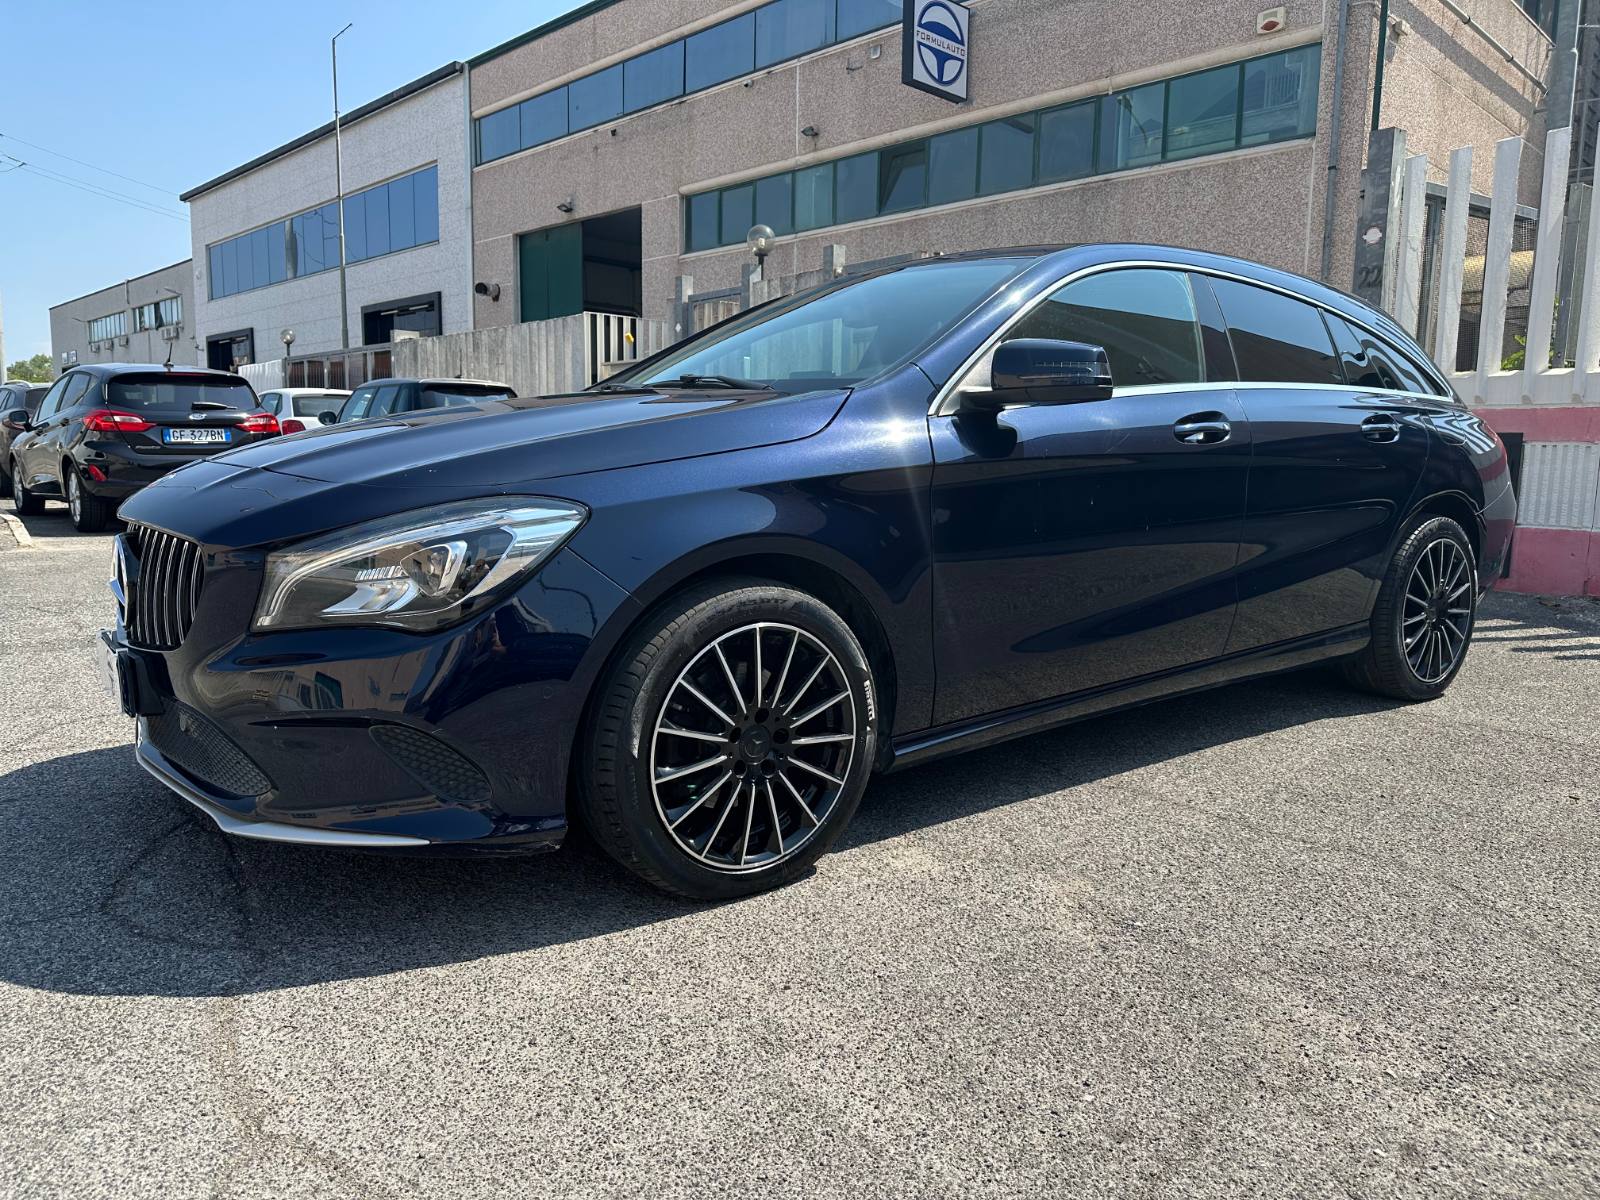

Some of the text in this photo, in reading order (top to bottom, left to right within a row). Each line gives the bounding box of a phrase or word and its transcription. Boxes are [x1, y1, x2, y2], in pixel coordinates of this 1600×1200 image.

[916, 30, 966, 57] FORMULAUTO
[172, 430, 224, 440] GF 327BN
